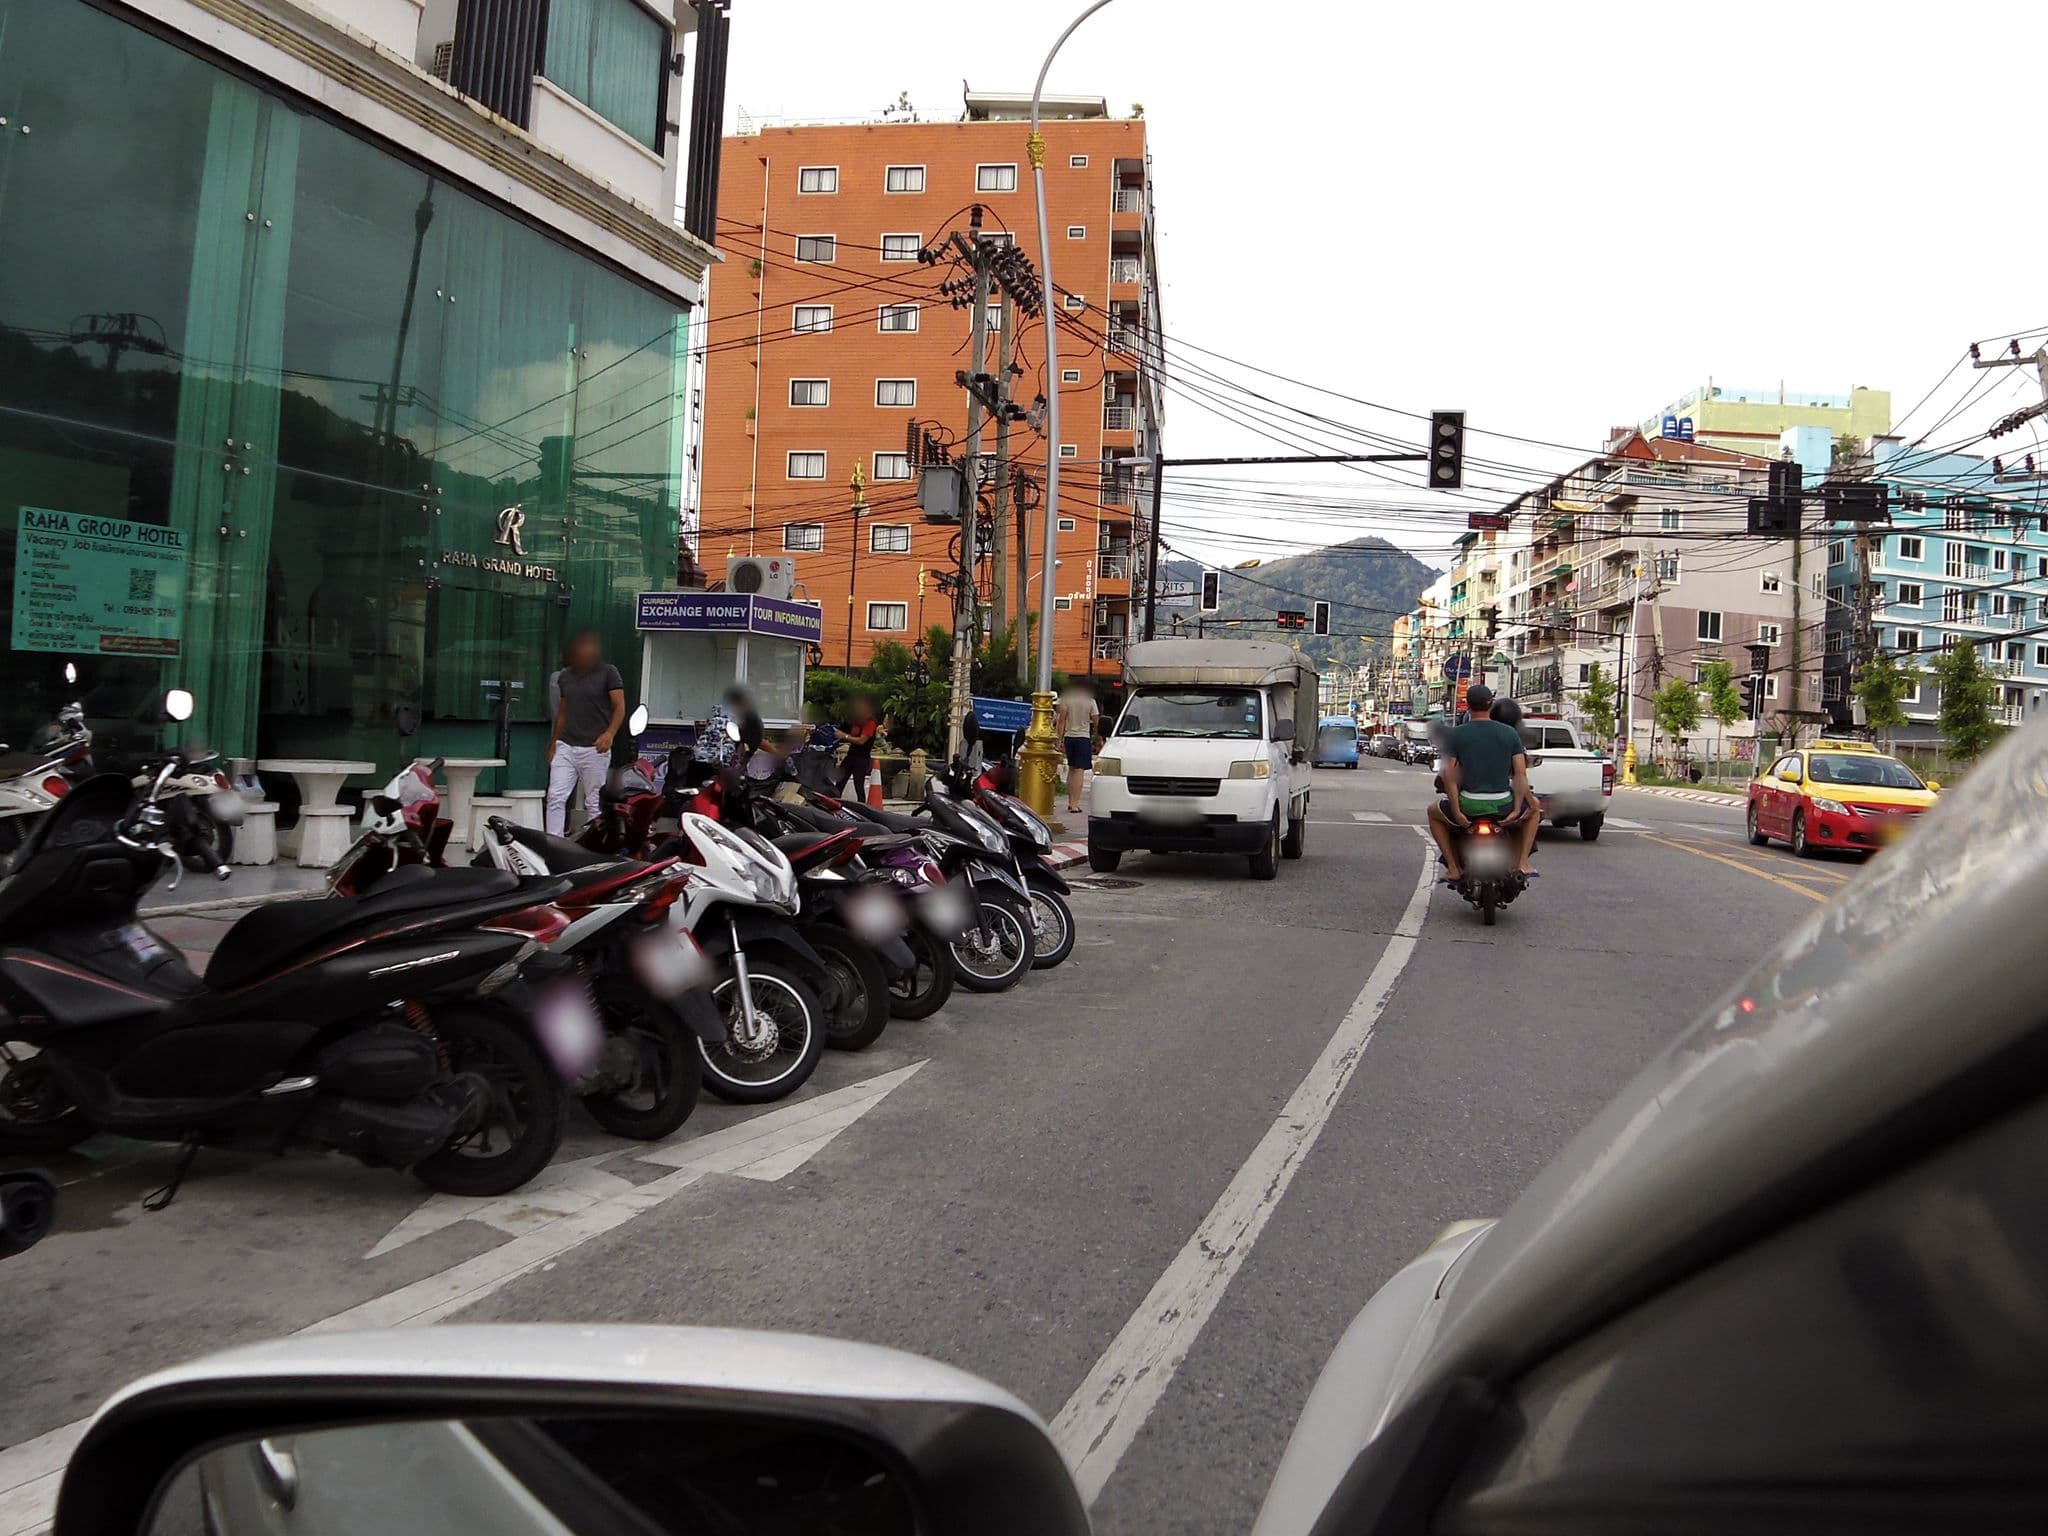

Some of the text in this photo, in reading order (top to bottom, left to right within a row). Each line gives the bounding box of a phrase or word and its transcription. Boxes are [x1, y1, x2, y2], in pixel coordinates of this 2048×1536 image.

[25, 511, 182, 546] RAHA GROUP HOTEL
[442, 551, 558, 583] RAHA GRAND HOTEL
[641, 606, 747, 618] EXCHANGE MONEY
[642, 597, 680, 605] CURRENCY
[753, 606, 820, 629] TOUR INFORMATION
